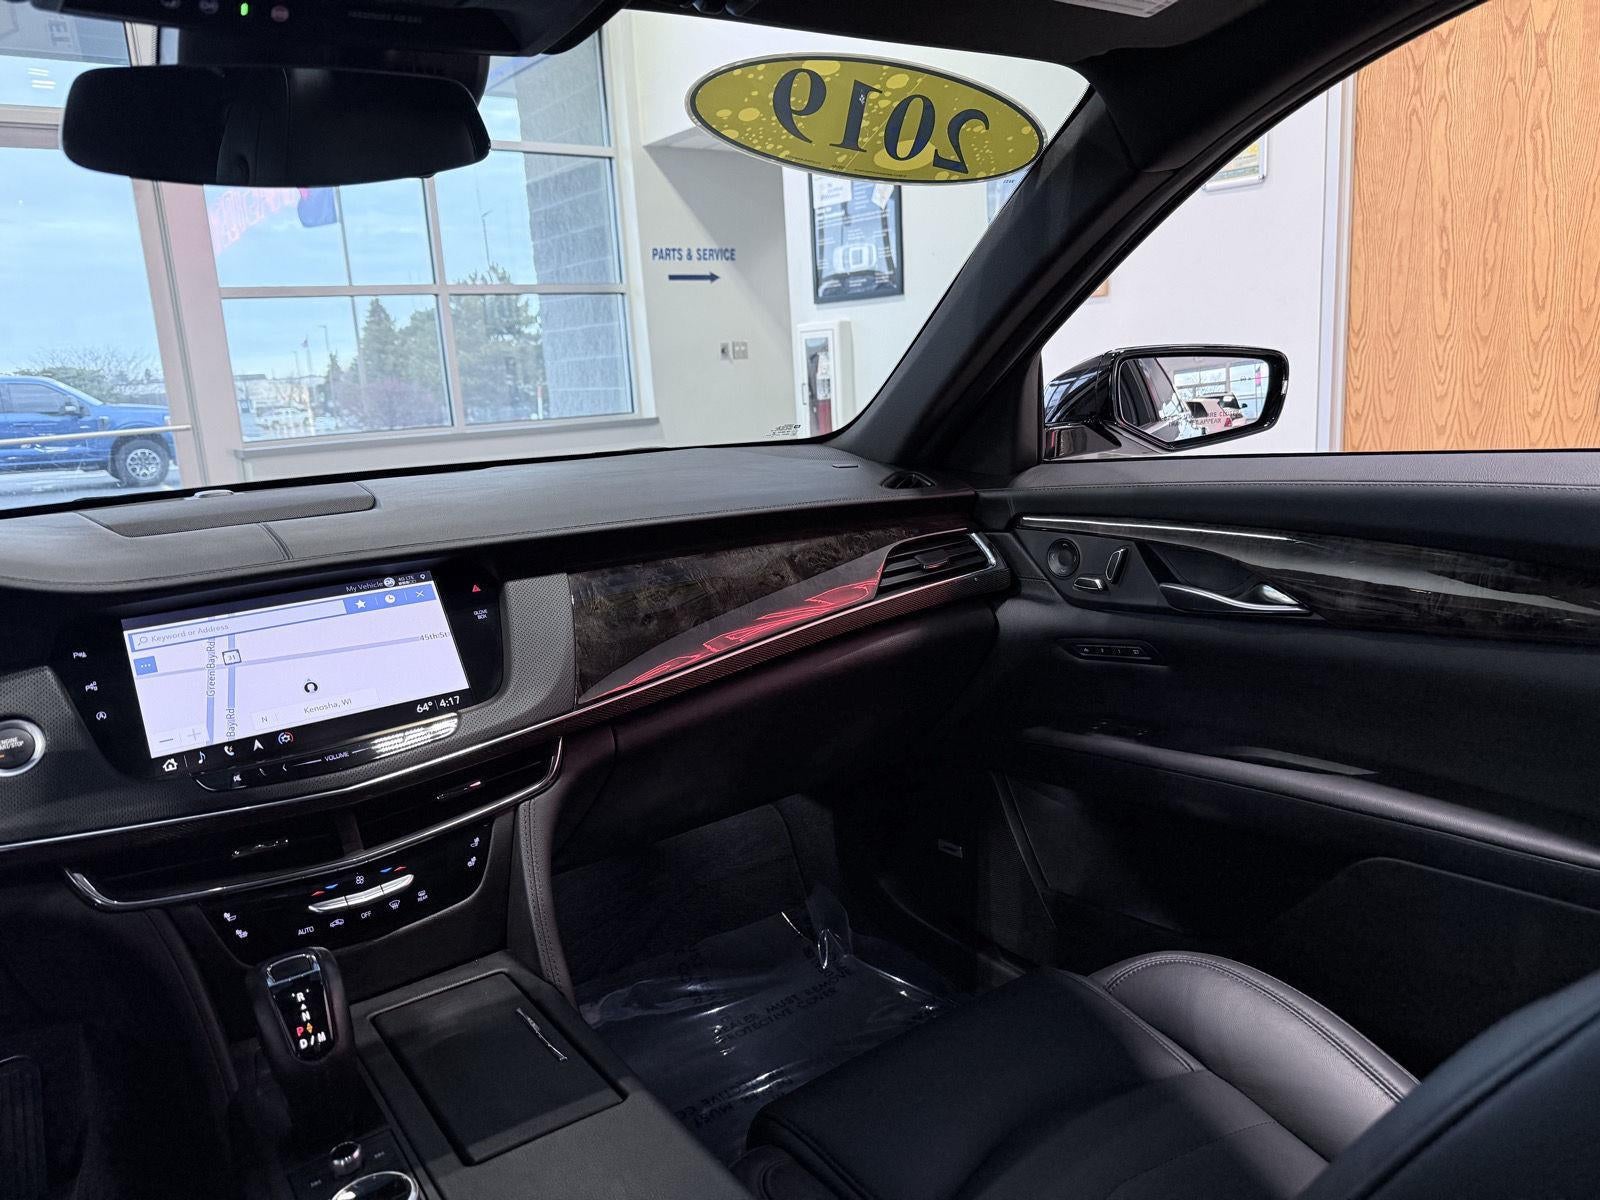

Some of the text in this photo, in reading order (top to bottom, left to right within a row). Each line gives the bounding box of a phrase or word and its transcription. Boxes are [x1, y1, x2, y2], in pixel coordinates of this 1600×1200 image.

[652, 247, 736, 261] PARTS & SERVICE
[345, 580, 384, 593] My Vehicle
[151, 630, 186, 643] Keyword
[197, 624, 229, 635] Address
[206, 641, 218, 697] Green Bay Rd
[303, 698, 353, 715] Kenosha, WI
[416, 701, 433, 713] 64°
[439, 695, 460, 708] 4:17
[226, 708, 238, 738] Bay Rd
[324, 751, 350, 762] VOLUME
[360, 910, 372, 919] OFF
[297, 926, 315, 936] AUTO
[296, 991, 306, 1002] R
[301, 1010, 311, 1022] N
[296, 1026, 304, 1037] P
